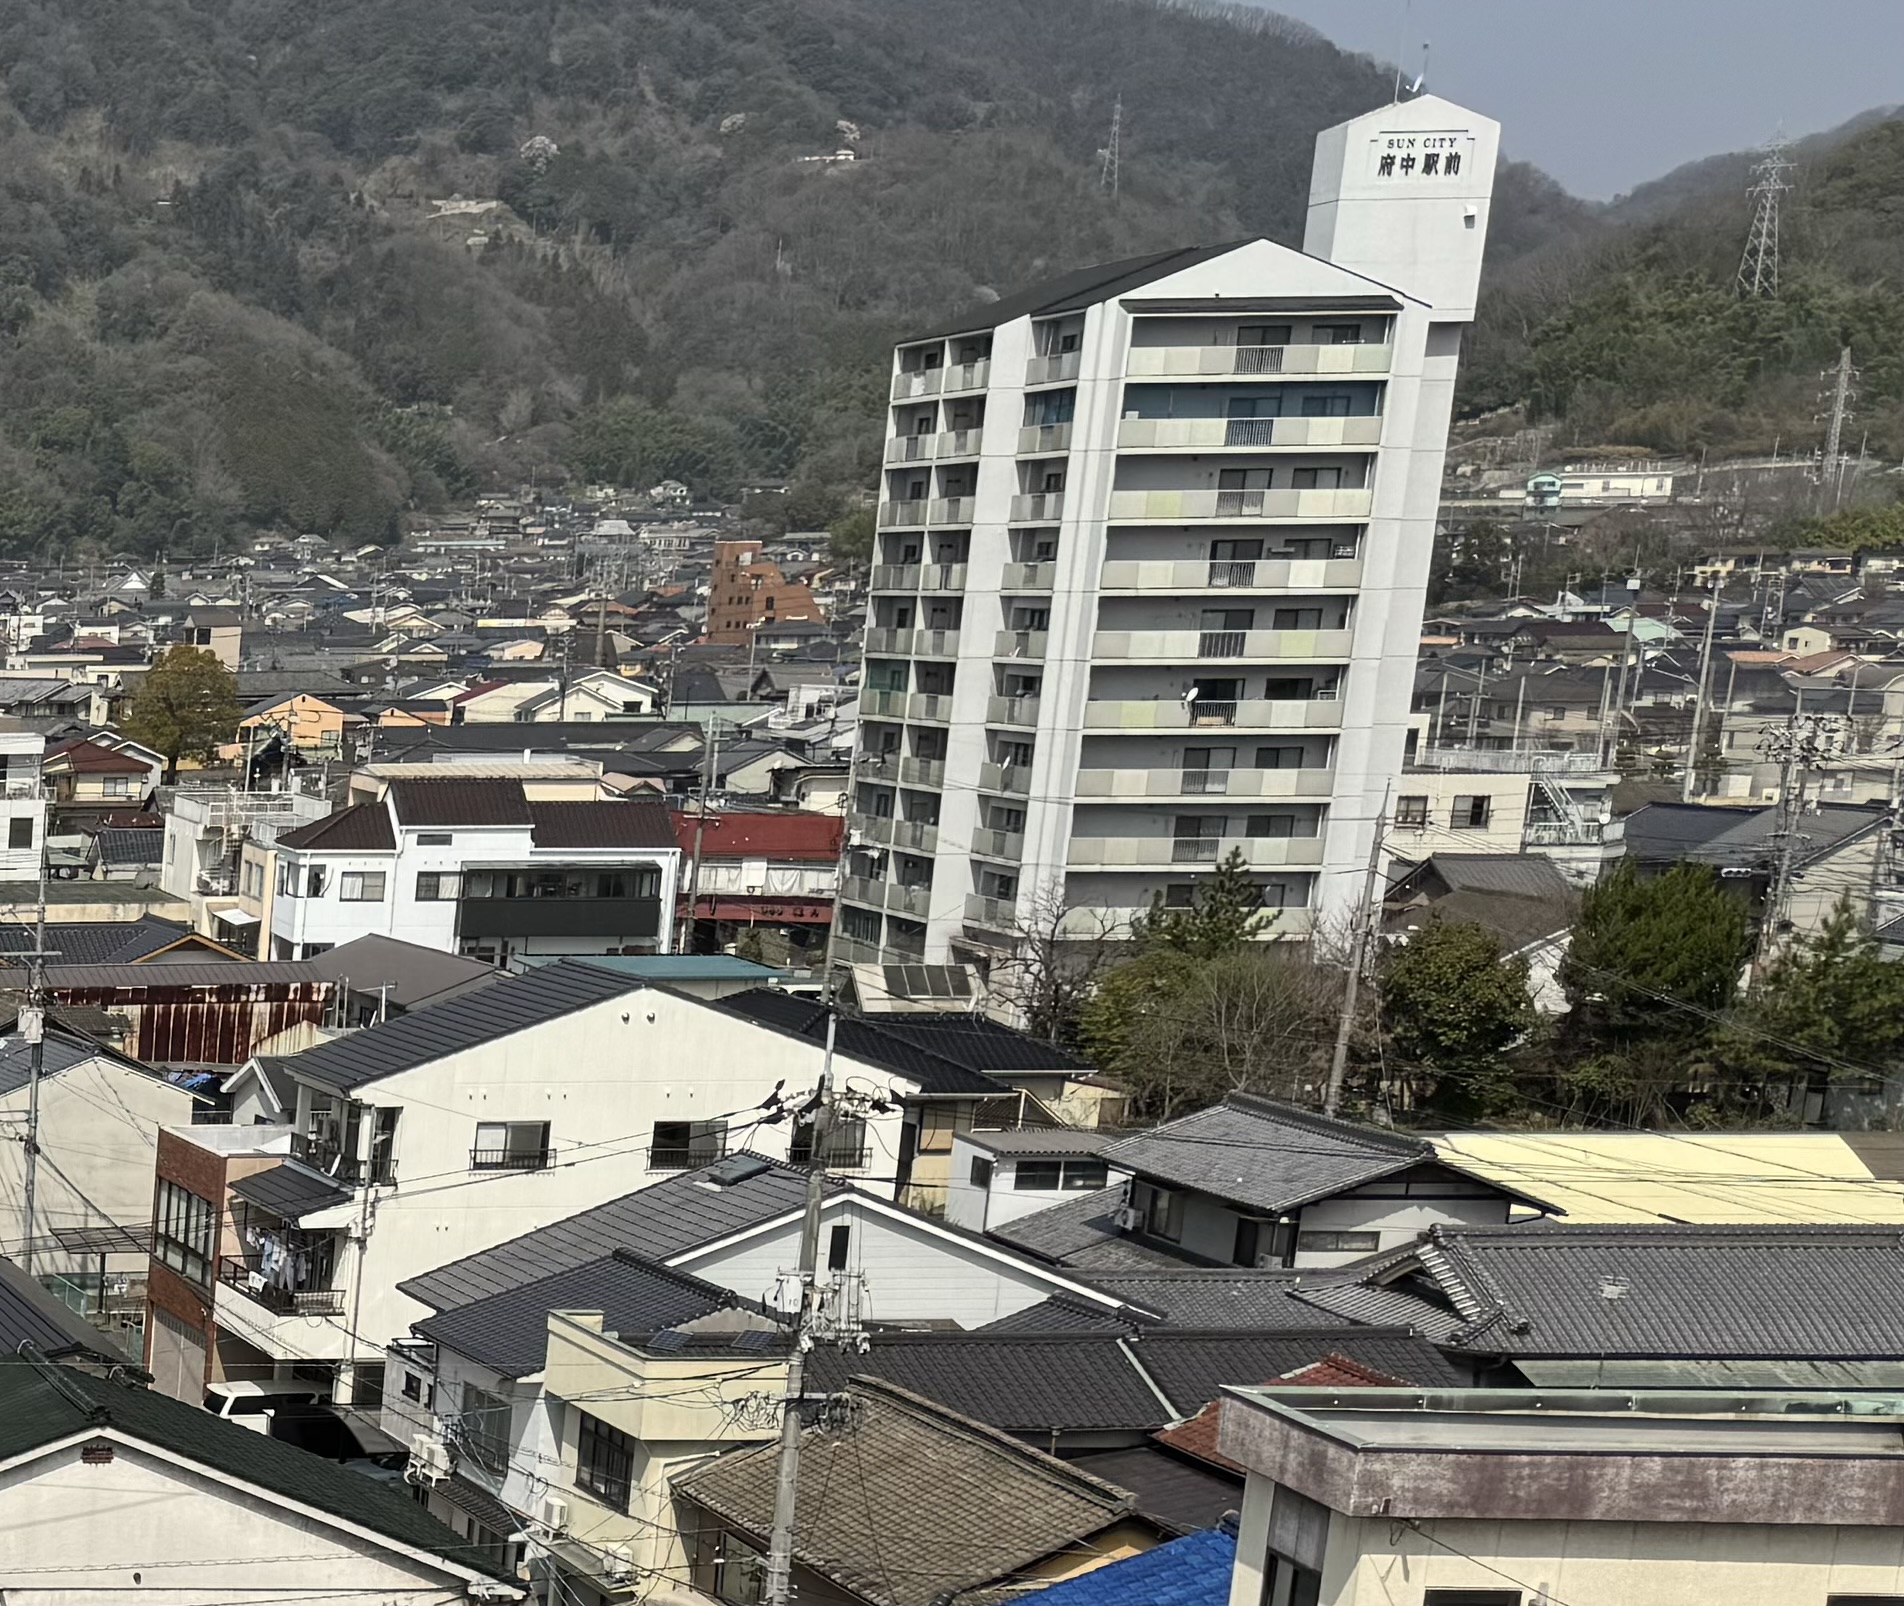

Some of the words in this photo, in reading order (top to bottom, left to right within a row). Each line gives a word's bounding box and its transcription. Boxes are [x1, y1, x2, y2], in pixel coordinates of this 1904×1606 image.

[1387, 138, 1416, 149] SUN
[1423, 137, 1457, 148] CITY
[1377, 151, 1462, 177] 府中駅前
